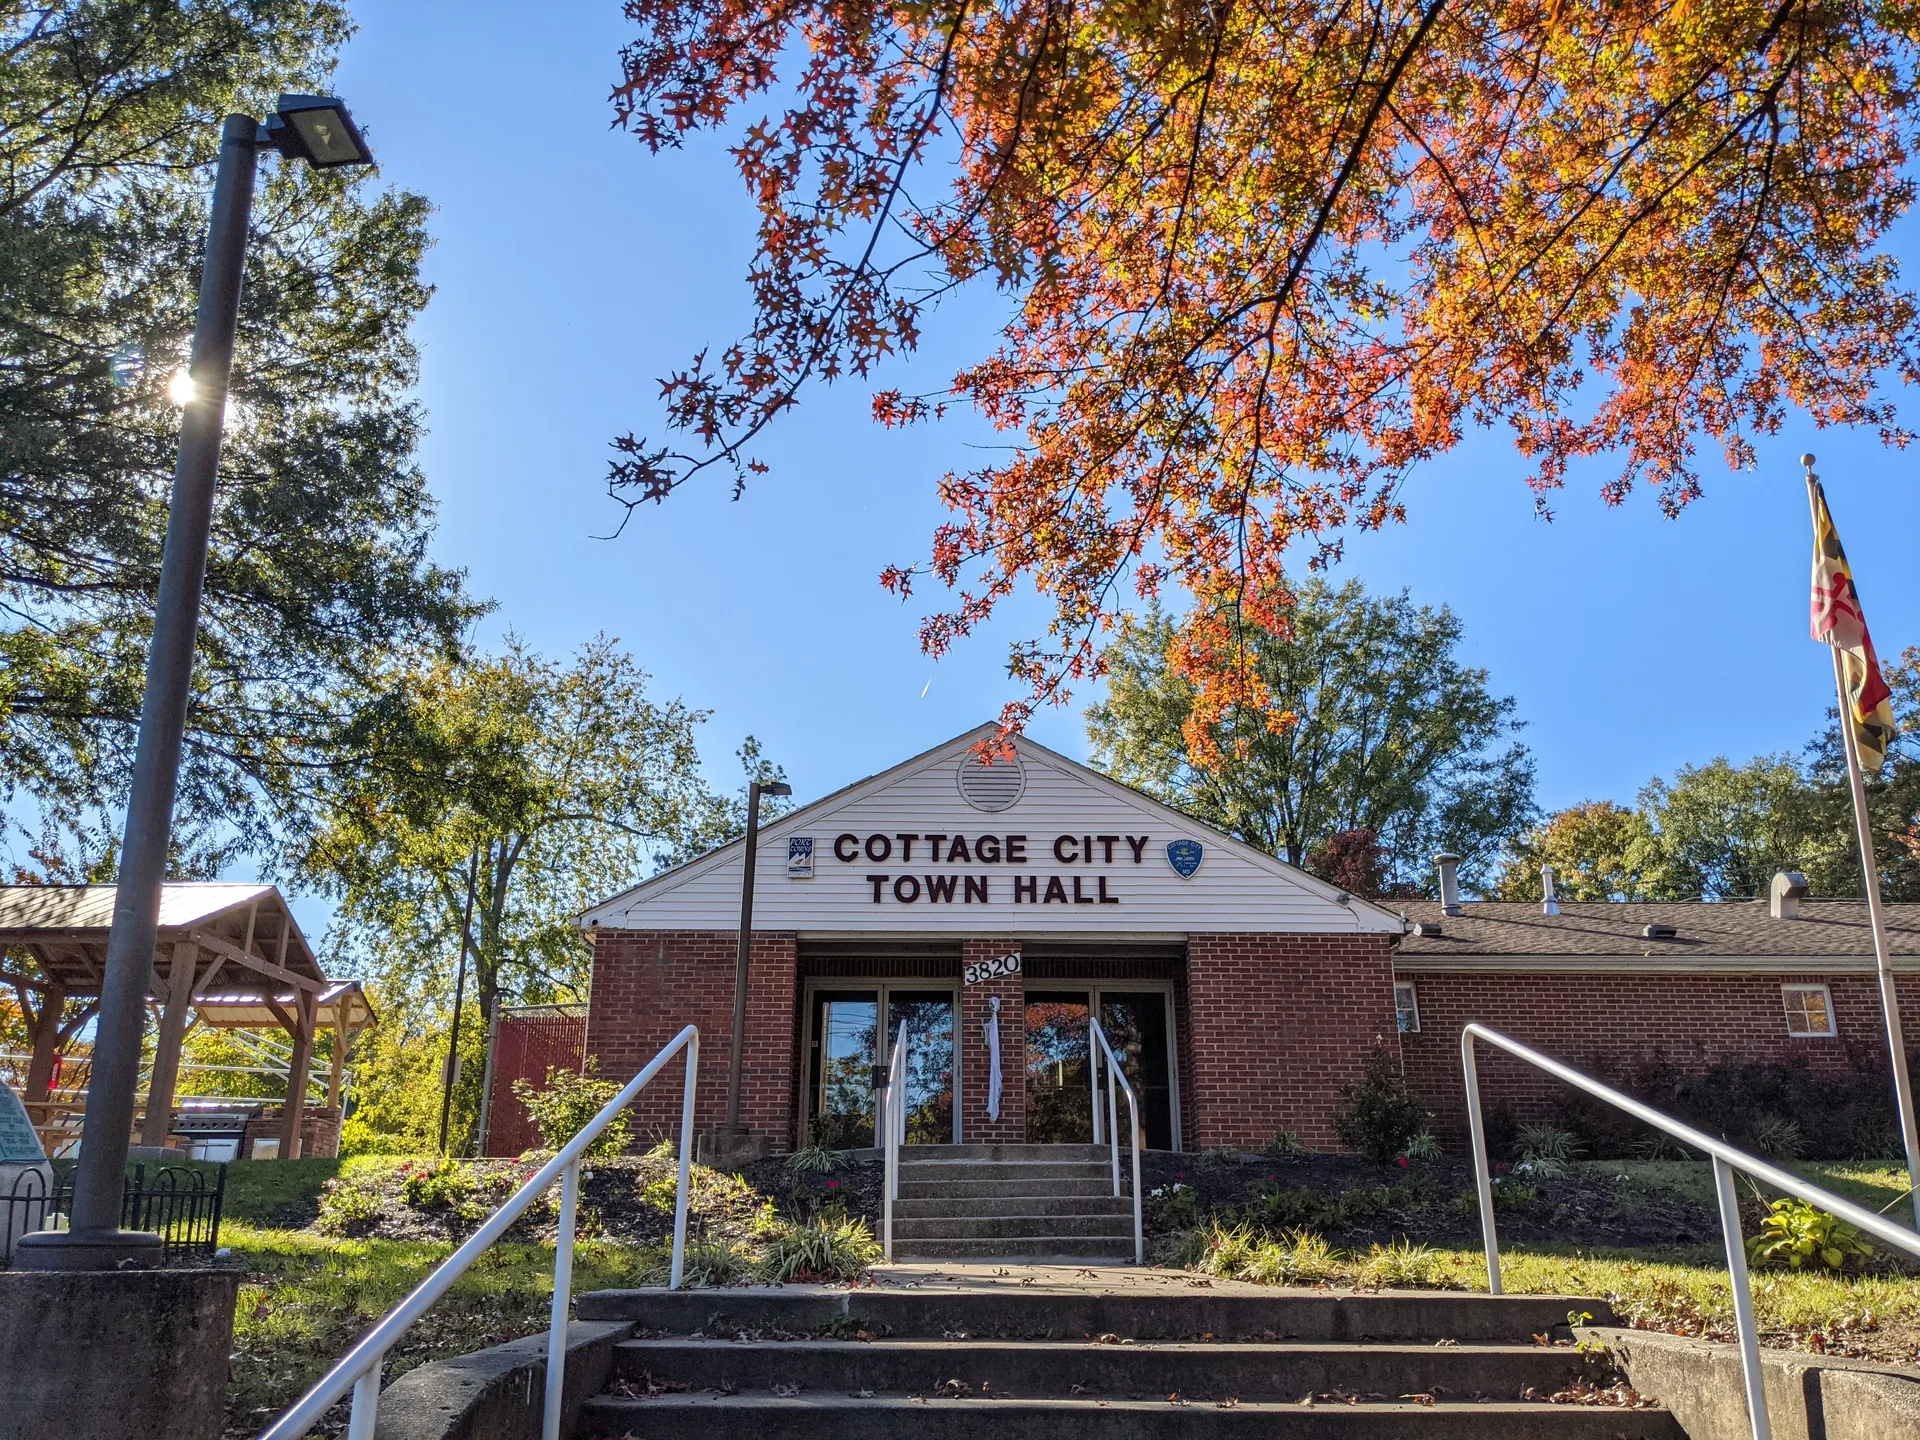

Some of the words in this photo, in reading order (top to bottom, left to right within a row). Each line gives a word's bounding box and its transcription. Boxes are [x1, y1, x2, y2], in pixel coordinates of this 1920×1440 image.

[790, 838, 812, 846] PORT
[833, 833, 1027, 863] COTTAGE
[1053, 835, 1149, 863] CITY
[1167, 840, 1189, 850] COTTAGE
[1190, 842, 1202, 850] CITY
[866, 874, 988, 904] TOWN
[1014, 875, 1120, 904] HALL
[965, 954, 1020, 984] 3820
